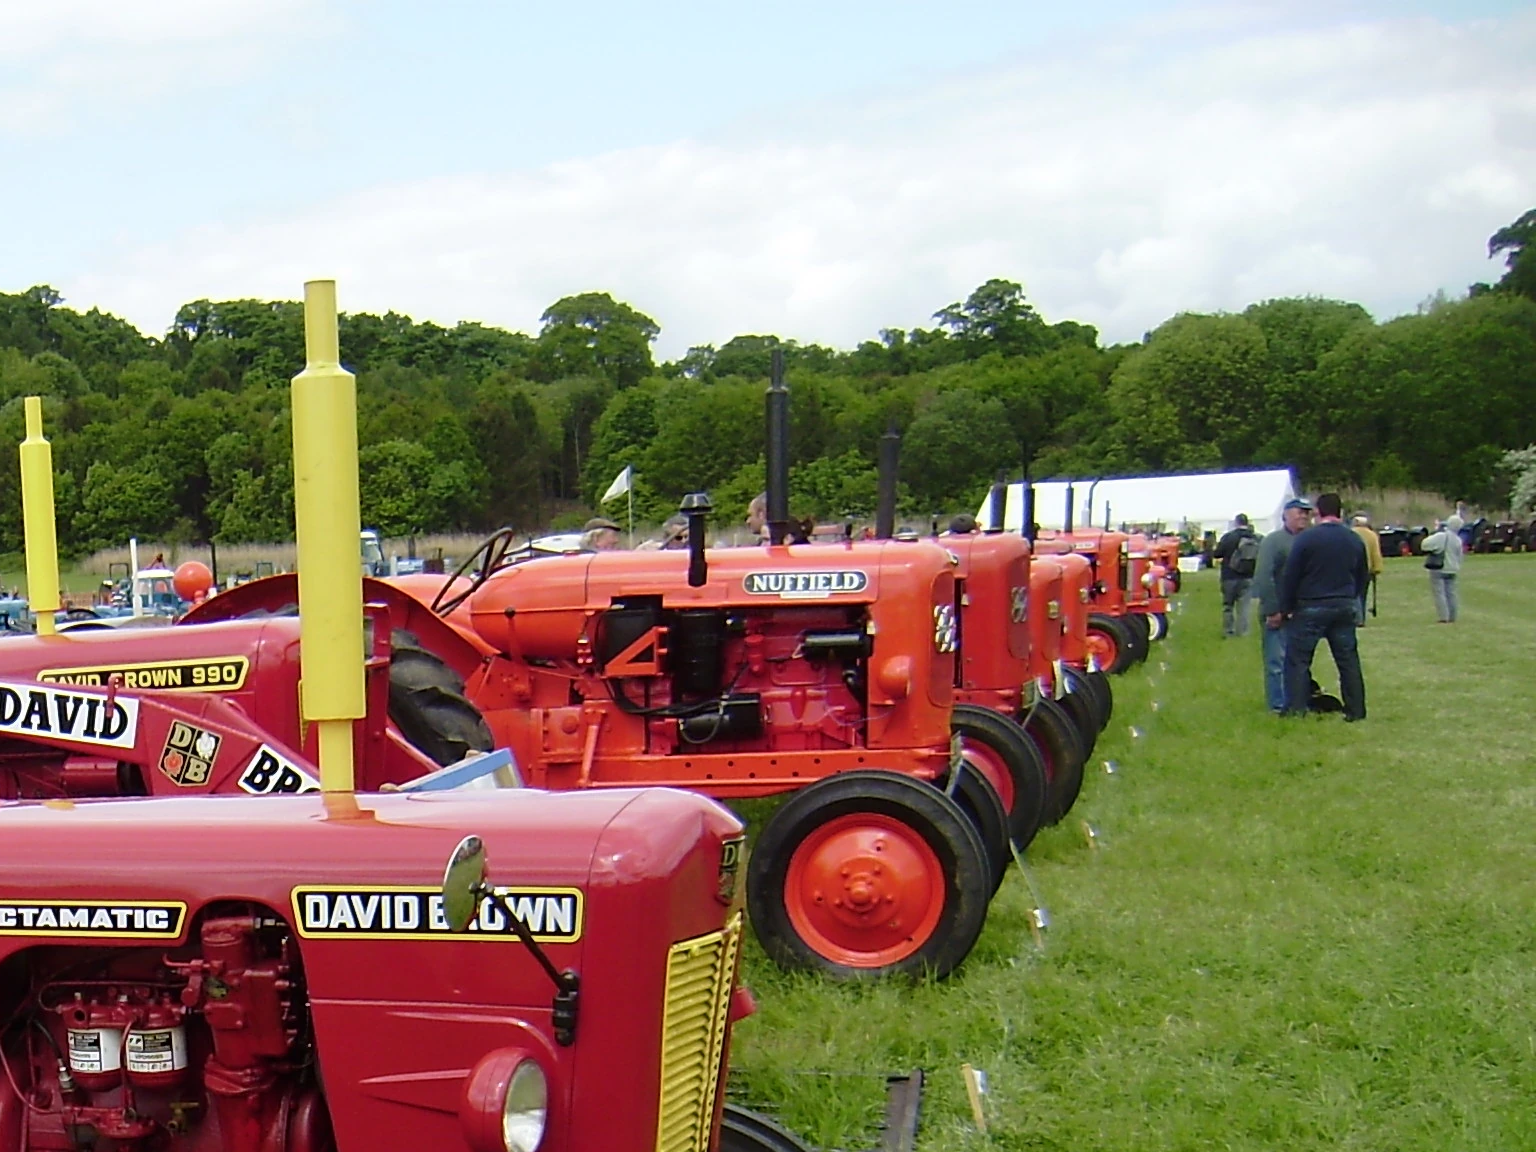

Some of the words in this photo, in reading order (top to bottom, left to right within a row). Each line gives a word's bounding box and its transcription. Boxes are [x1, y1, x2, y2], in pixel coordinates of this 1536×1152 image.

[752, 573, 859, 592] NUFFIELD
[113, 669, 182, 689] ROWN
[192, 665, 236, 684] 990
[170, 724, 192, 748] D
[184, 759, 207, 782] B
[243, 749, 321, 794] BR
[305, 894, 419, 930] DAVID
[429, 895, 572, 933] BOWN
